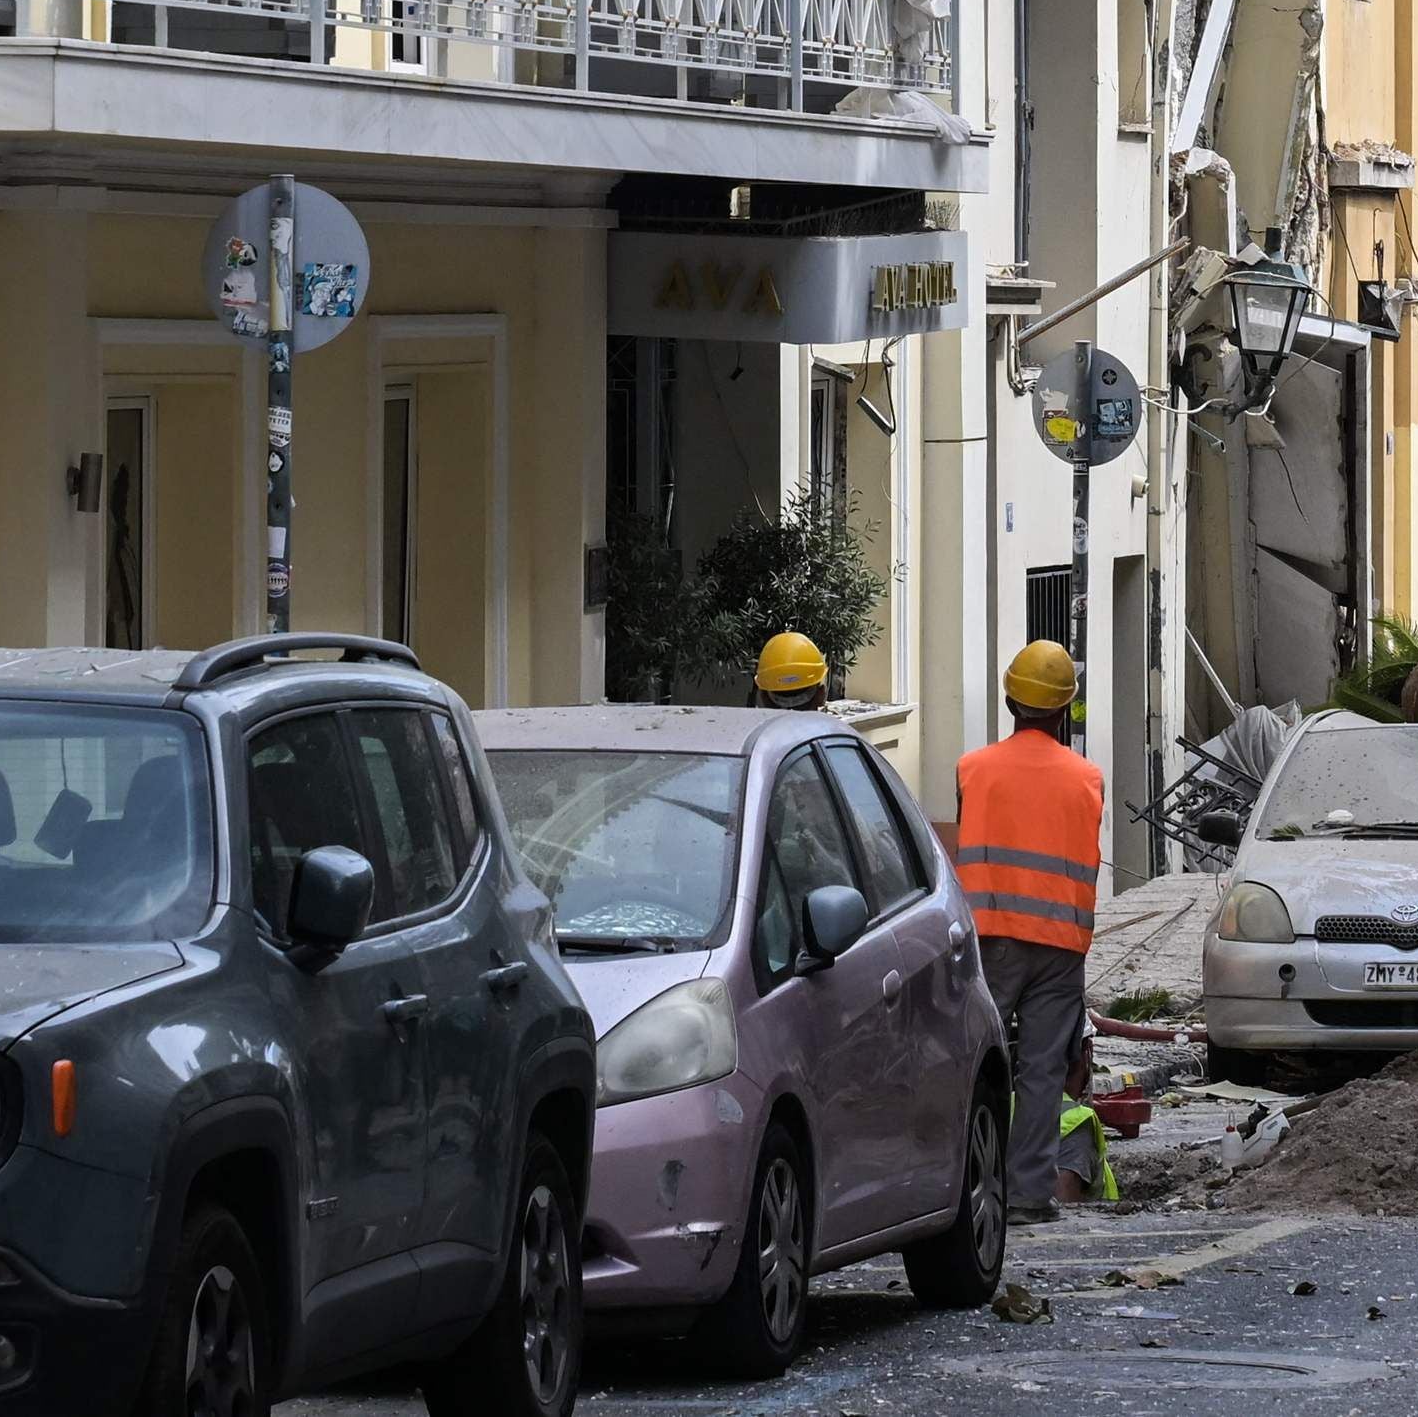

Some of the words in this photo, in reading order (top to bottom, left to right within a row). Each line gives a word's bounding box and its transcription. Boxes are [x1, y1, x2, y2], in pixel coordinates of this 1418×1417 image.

[653, 257, 784, 314] AVA
[875, 266, 906, 311] AVA
[911, 262, 957, 309] HOTEL
